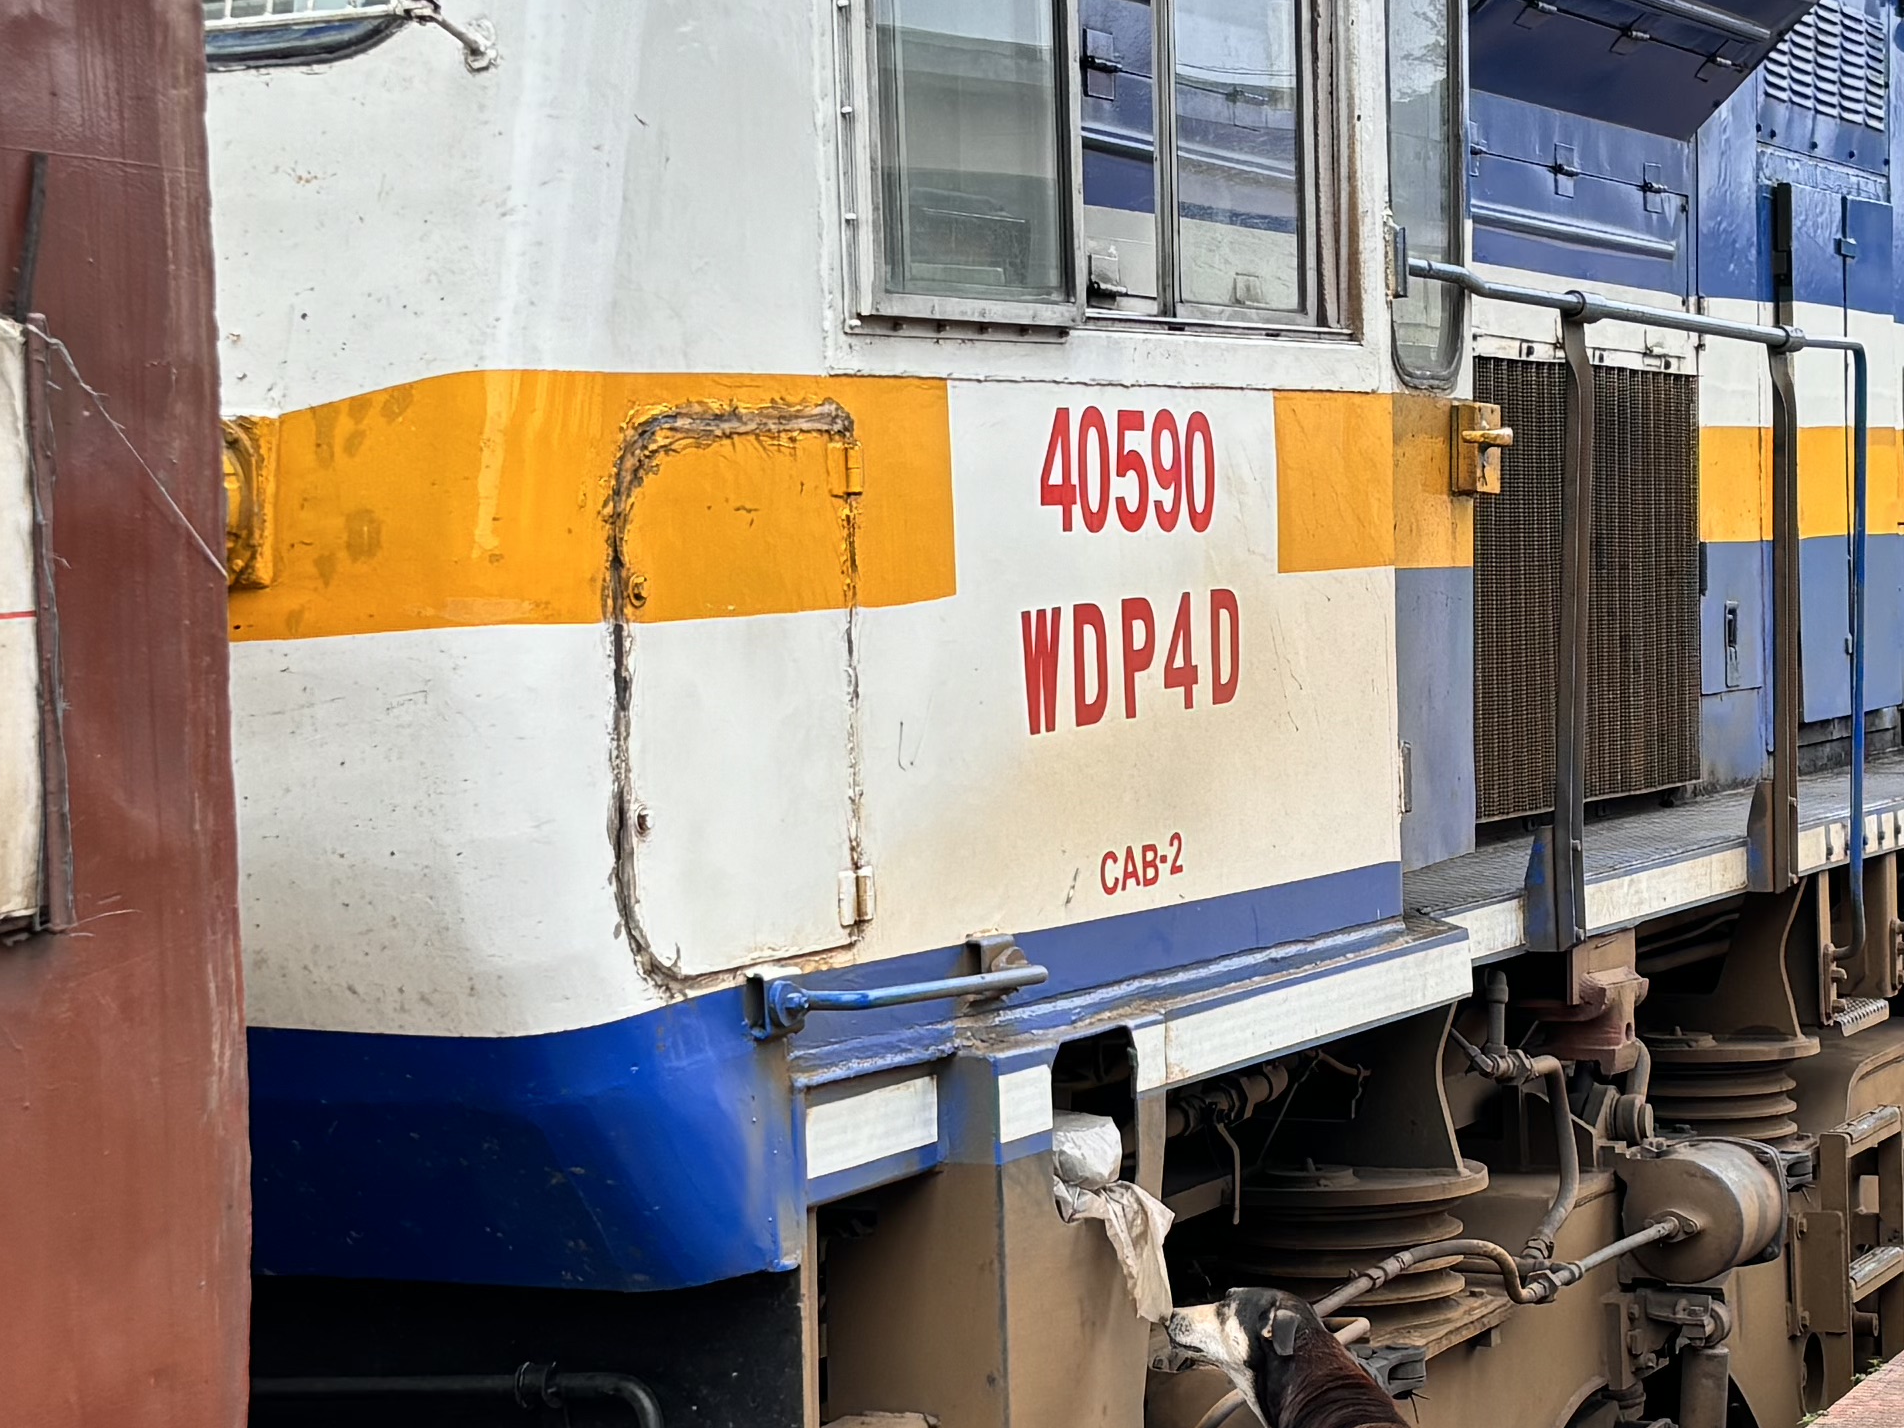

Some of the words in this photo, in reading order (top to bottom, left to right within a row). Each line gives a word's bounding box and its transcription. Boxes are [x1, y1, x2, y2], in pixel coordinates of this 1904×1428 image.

[1040, 406, 1216, 534] 40590
[1021, 588, 1241, 736] WDP4D
[1100, 832, 1184, 897] CAB-2
